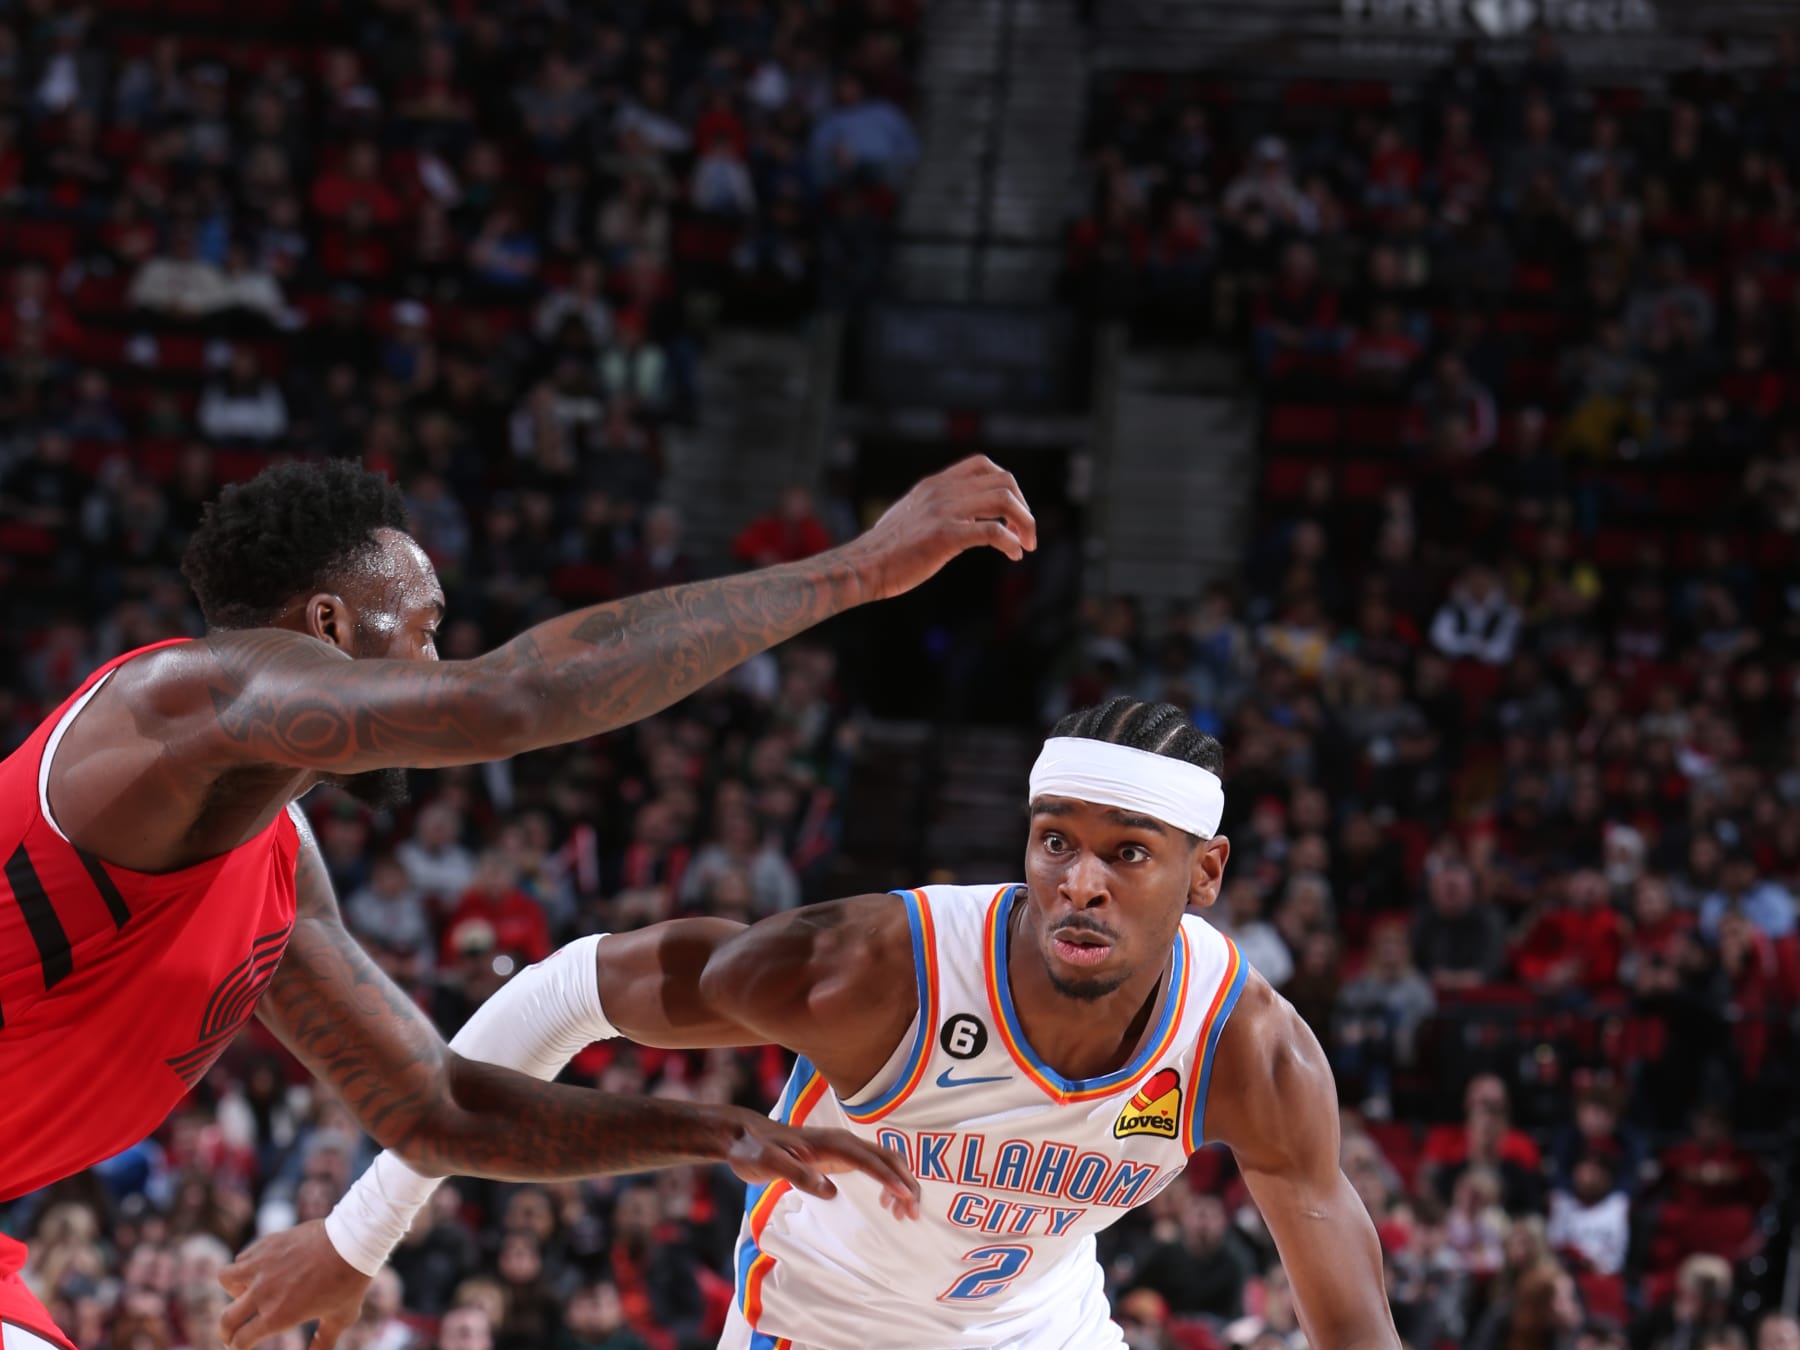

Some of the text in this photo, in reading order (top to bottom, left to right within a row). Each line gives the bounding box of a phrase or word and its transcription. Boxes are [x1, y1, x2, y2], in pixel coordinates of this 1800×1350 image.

[949, 1019, 978, 1055] 6
[947, 1192, 1086, 1236] CITY
[936, 1243, 1034, 1301] 2
